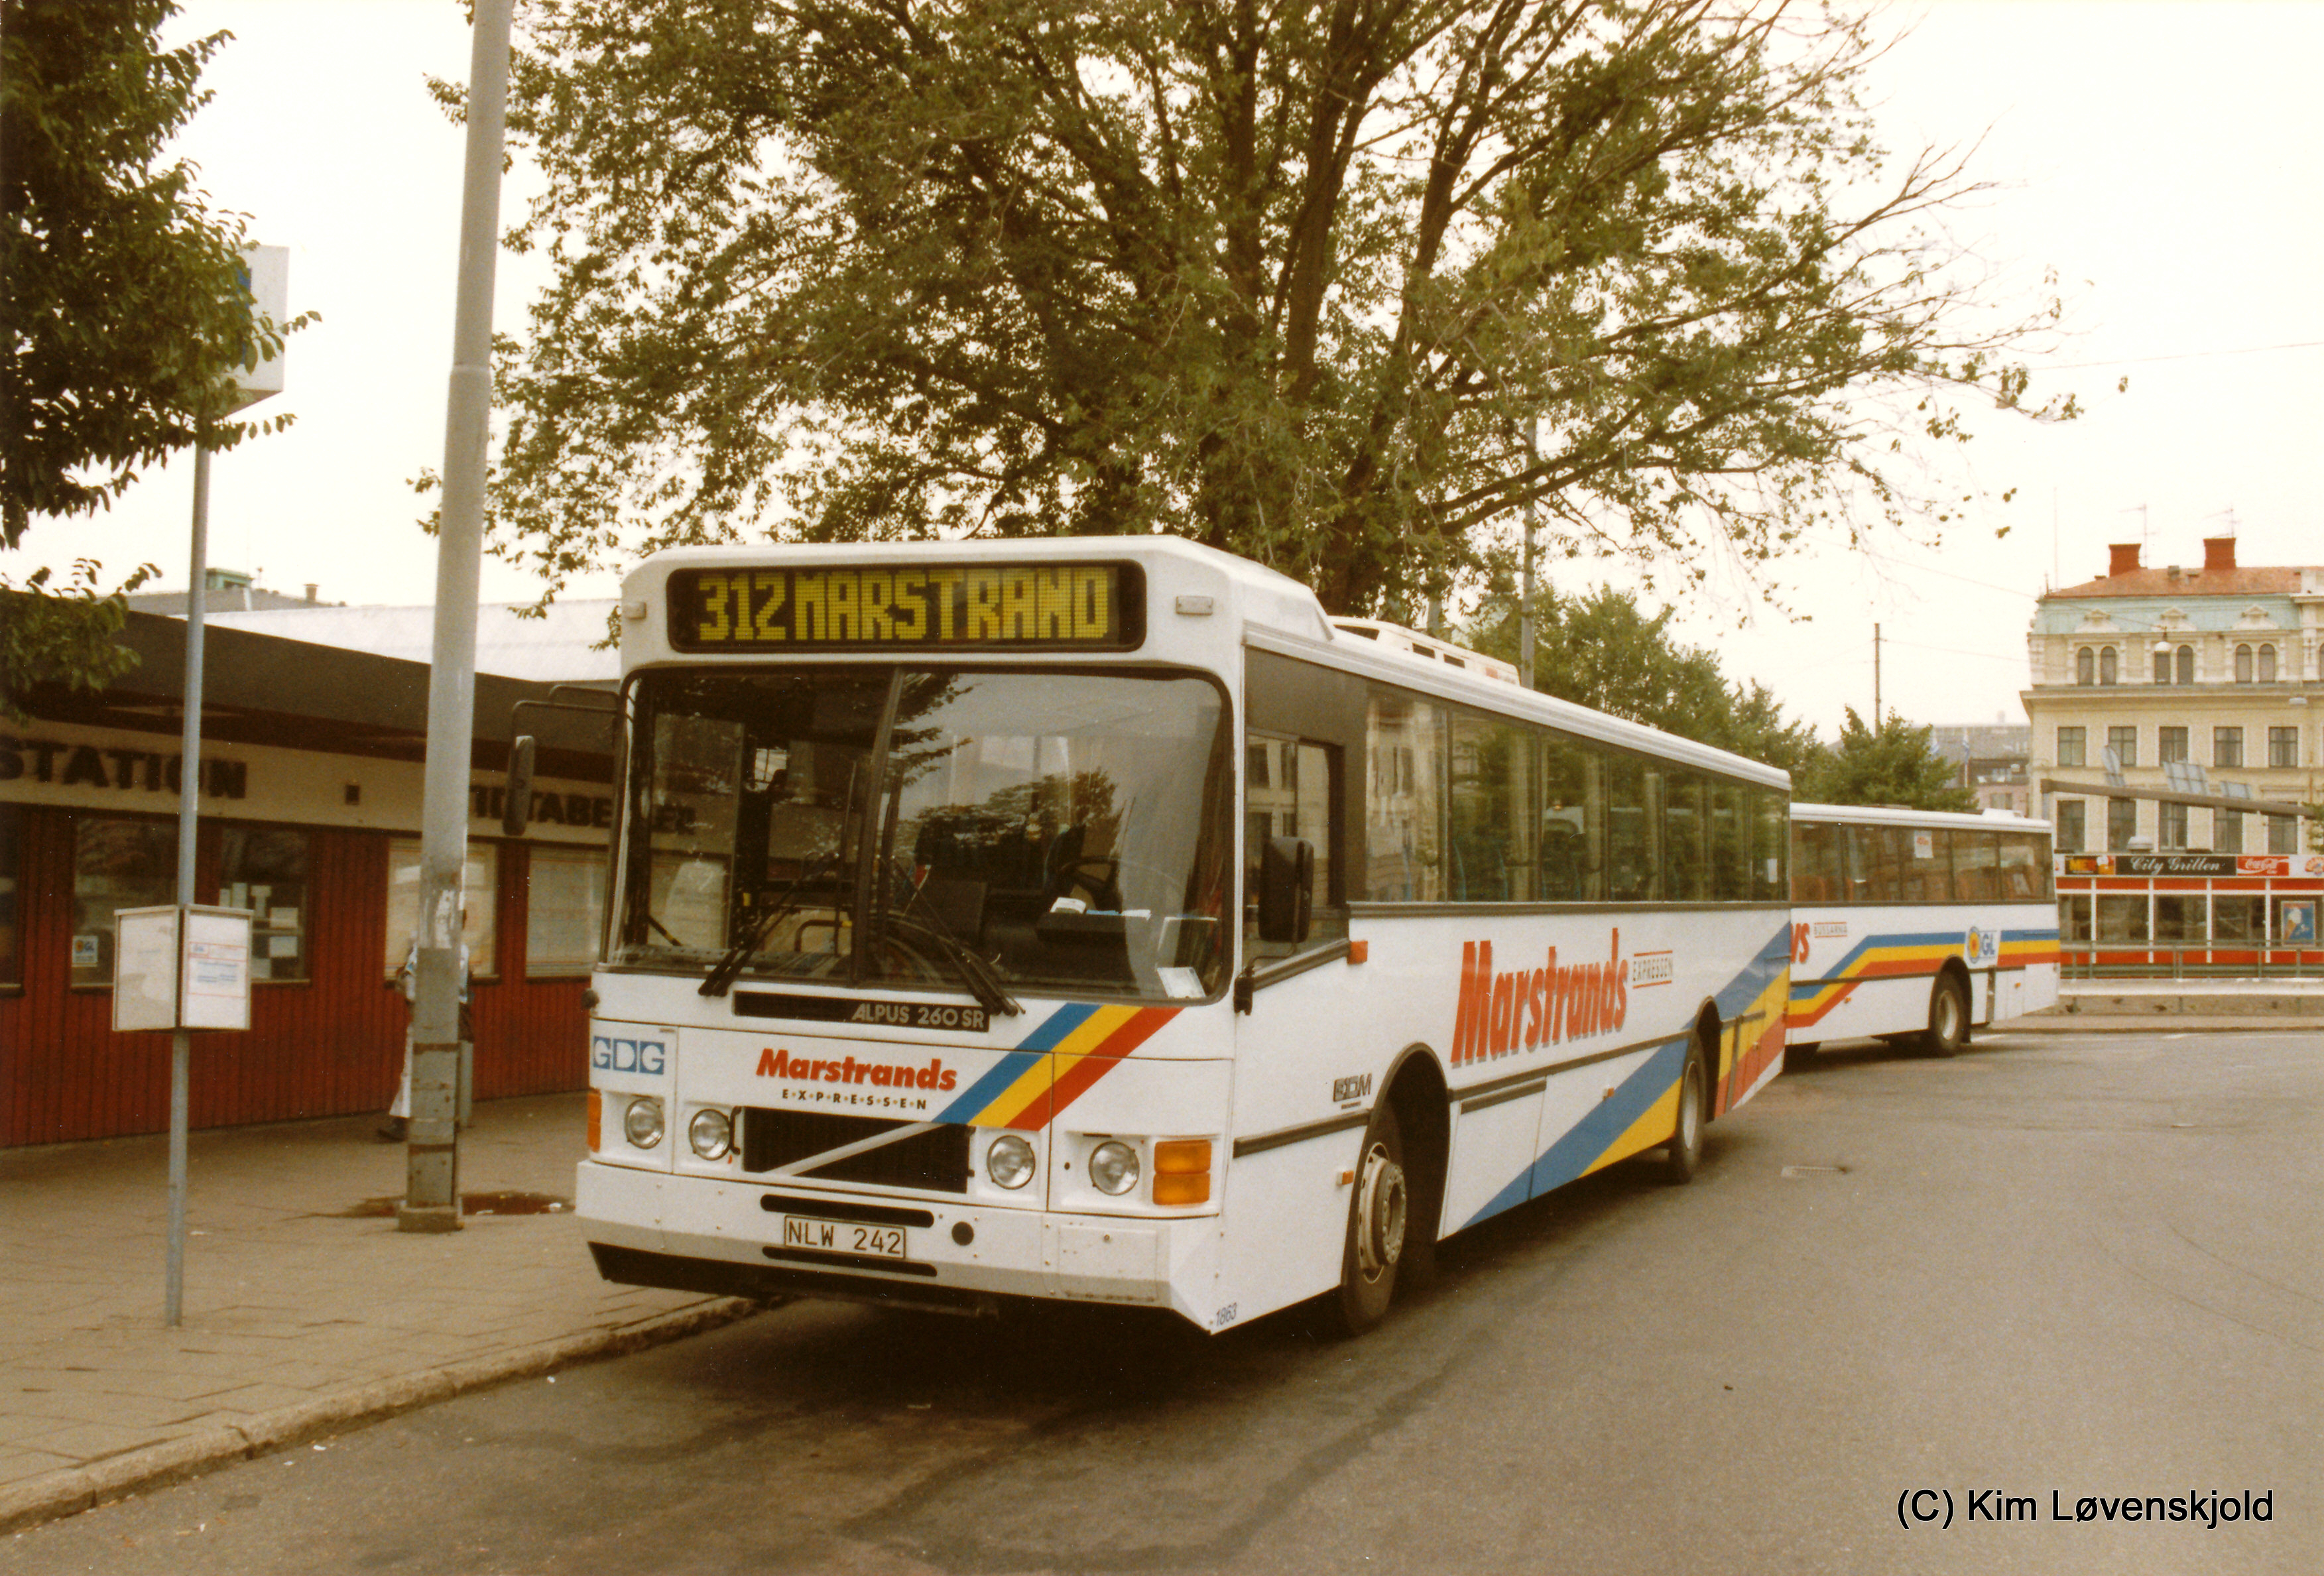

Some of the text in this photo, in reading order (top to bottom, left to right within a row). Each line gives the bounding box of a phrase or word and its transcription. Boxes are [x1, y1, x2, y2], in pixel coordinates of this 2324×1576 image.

[698, 566, 1109, 642] 312 MARSTRAND
[2131, 856, 2164, 872] City
[851, 1003, 984, 1028] ALPUS 260 SR
[1450, 928, 1629, 1069] Marstrands
[593, 1035, 665, 1075] GDG
[756, 1048, 957, 1091] Marstrands
[788, 1221, 900, 1254] NLW 242
